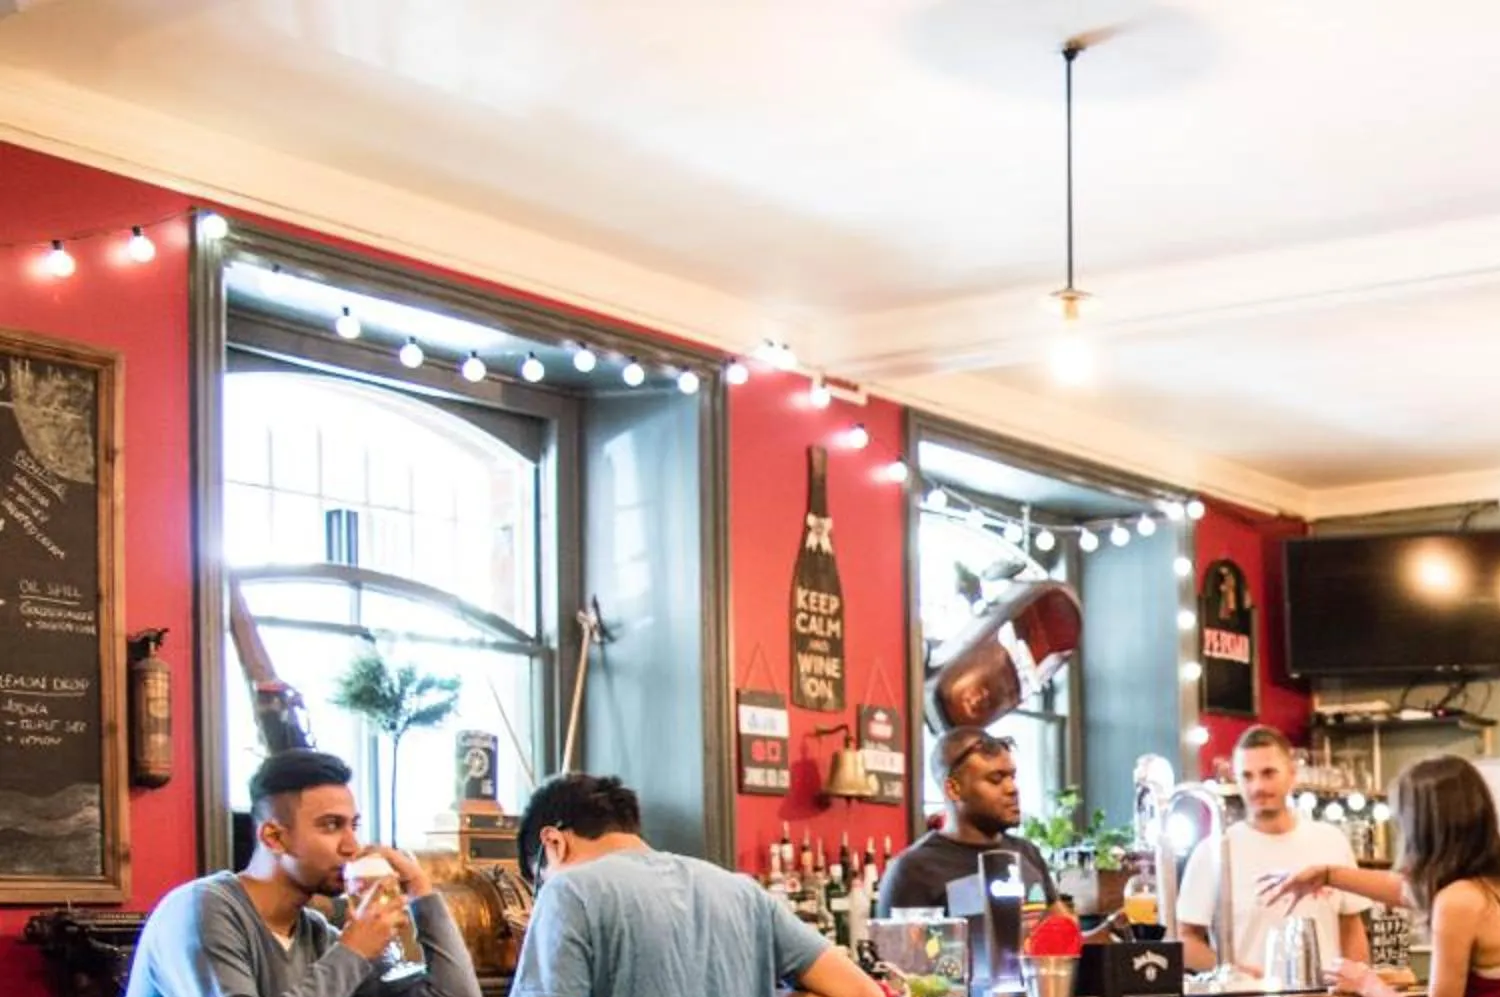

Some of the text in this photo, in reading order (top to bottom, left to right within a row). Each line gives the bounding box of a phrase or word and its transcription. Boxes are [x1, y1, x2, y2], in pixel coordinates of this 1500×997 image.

[796, 587, 840, 615] KEEP
[796, 612, 841, 640] CALM
[797, 651, 841, 679] WINE
[805, 677, 834, 700] ON
